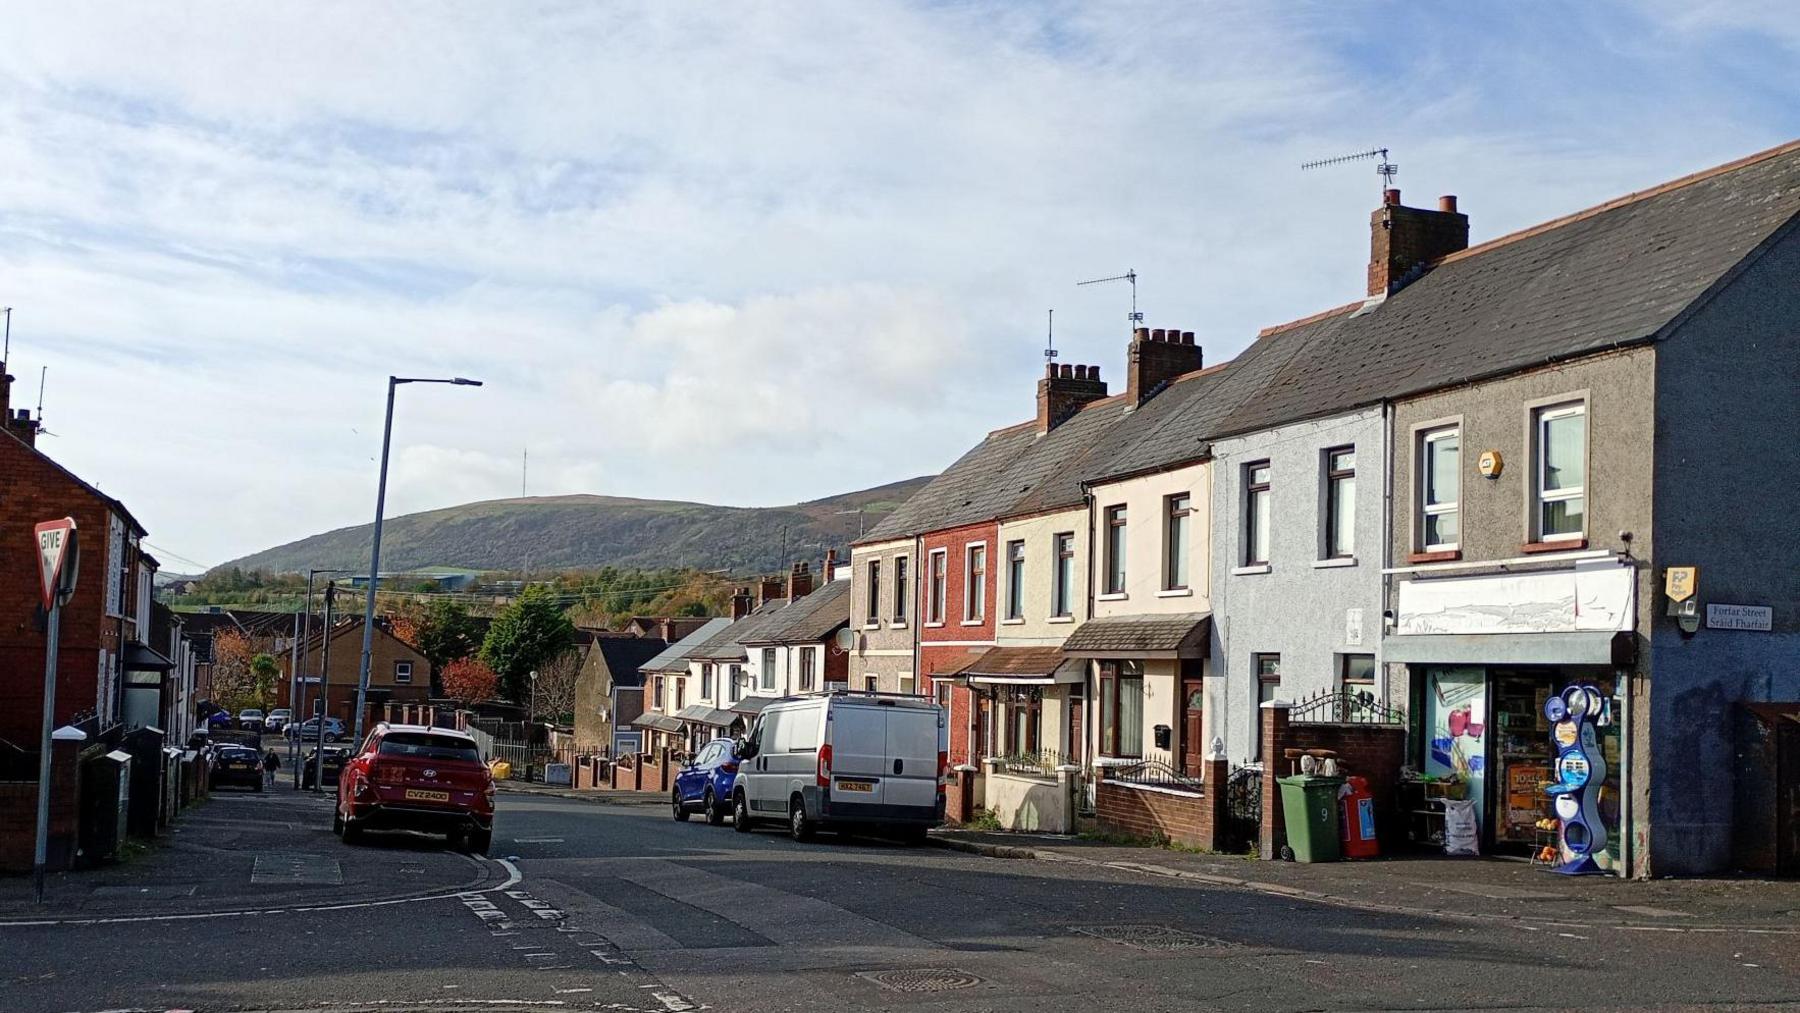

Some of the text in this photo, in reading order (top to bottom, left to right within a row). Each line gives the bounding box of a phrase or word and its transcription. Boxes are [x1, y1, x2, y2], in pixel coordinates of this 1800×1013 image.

[41, 531, 60, 550] GIVE
[1713, 606, 1767, 617] Forfar Street
[407, 790, 448, 801] CVZ 2400
[1321, 808, 1328, 822] 9
